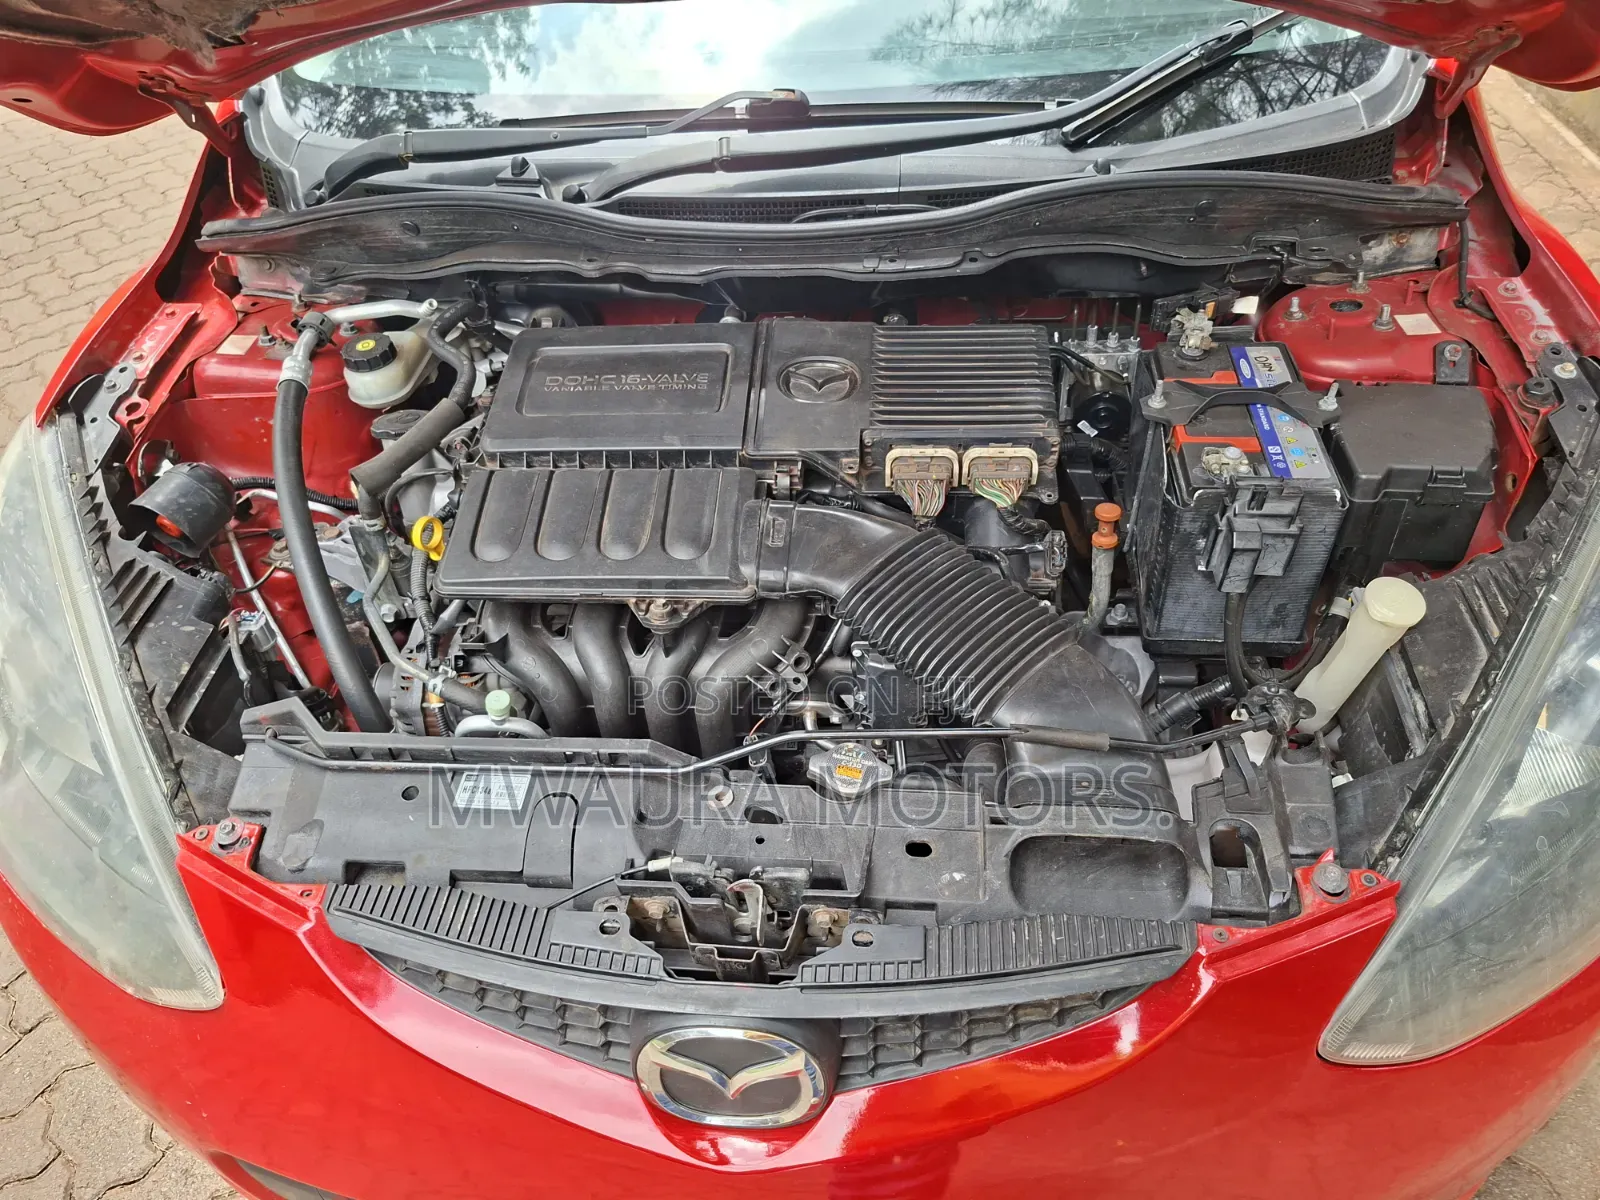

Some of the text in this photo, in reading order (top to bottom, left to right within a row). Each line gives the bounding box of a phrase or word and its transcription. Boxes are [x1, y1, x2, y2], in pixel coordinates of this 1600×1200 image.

[544, 373, 709, 386] DOHC 16-VALVE
[1257, 407, 1271, 431] STANDARD
